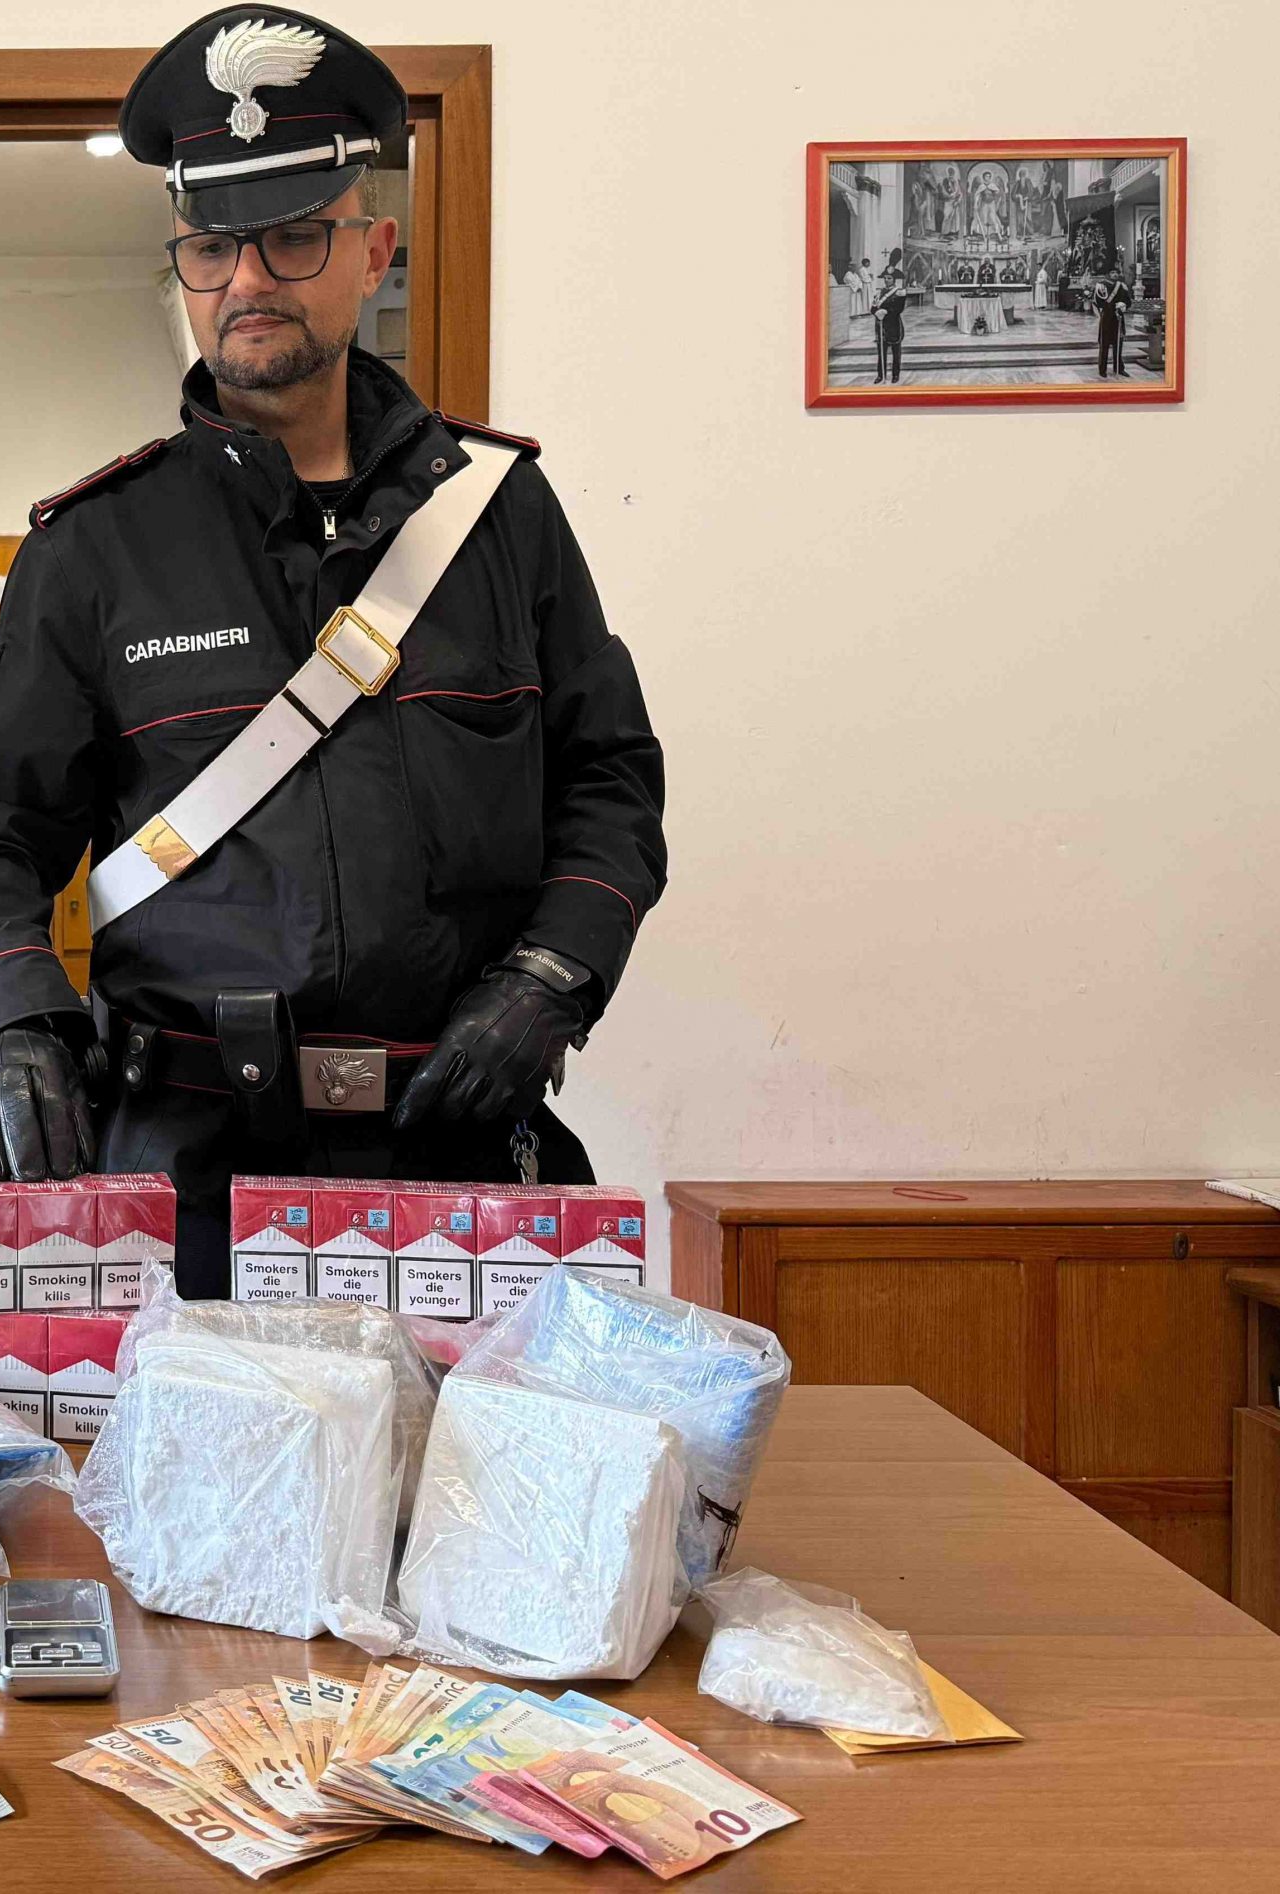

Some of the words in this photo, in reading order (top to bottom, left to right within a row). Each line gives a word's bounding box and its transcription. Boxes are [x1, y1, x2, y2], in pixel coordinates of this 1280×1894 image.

[125, 627, 250, 664] CARABINIERI
[516, 949, 574, 982] CARABINIERI
[245, 1263, 298, 1274] Smokers
[325, 1266, 379, 1278] Smokers
[408, 1268, 462, 1281] Smokers
[28, 1273, 87, 1286] Smoking
[263, 1276, 281, 1286] die
[343, 1279, 362, 1289] die
[425, 1282, 444, 1292] die
[509, 1286, 528, 1297] die
[45, 1290, 71, 1301] kills
[247, 1288, 297, 1300] younger
[328, 1291, 378, 1303] younger
[409, 1295, 461, 1307] younger
[3, 1400, 39, 1415] oking
[59, 1402, 109, 1417] Smokin
[75, 1421, 101, 1434] kills
[317, 1682, 345, 1703] 50
[142, 1728, 183, 1745] 50
[98, 1735, 131, 1750] 50
[129, 1748, 162, 1766] EURO
[746, 1801, 770, 1813] EURO
[170, 1808, 236, 1842] 50
[695, 1809, 751, 1844] 10
[242, 1846, 271, 1860] EURO
